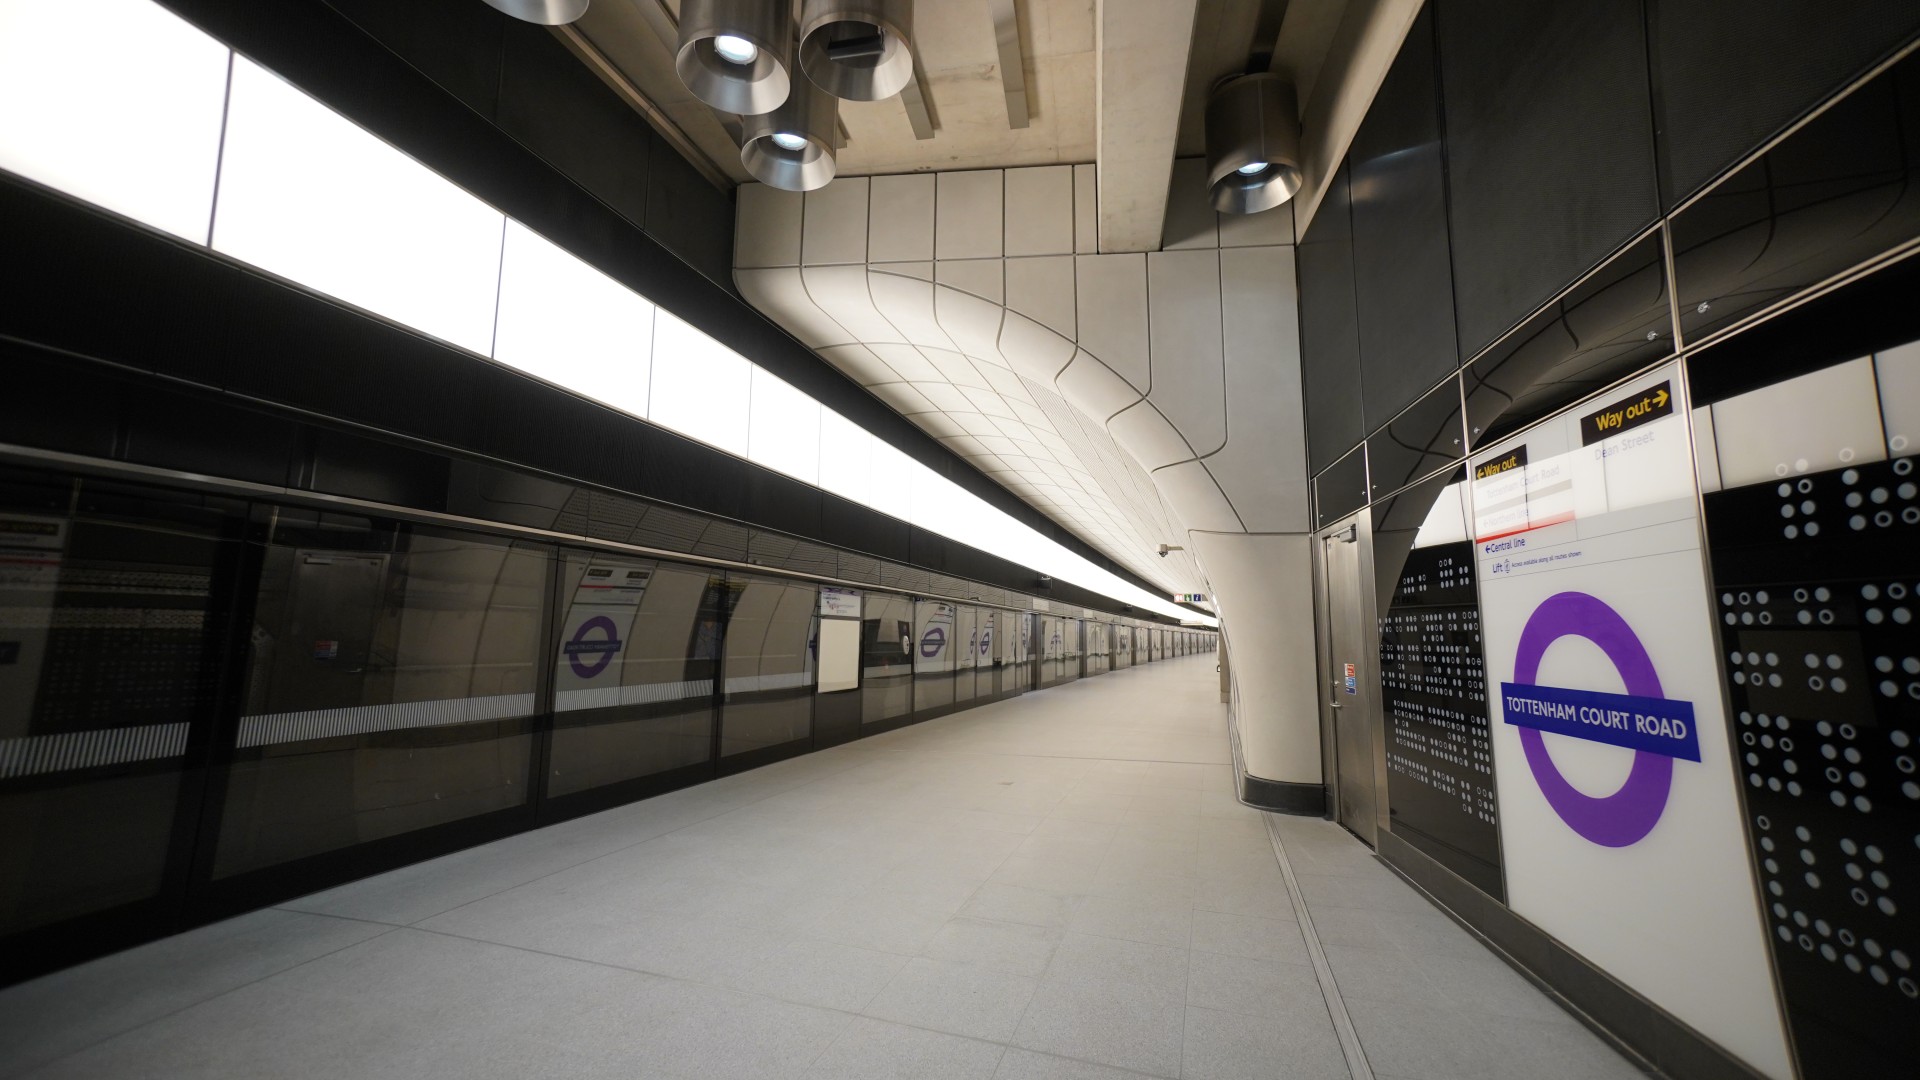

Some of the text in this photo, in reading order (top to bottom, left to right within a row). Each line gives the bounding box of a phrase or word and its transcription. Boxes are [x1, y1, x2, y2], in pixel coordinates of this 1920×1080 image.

[1596, 397, 1652, 431] Way out
[1594, 431, 1656, 461] Dean Street
[1502, 456, 1516, 470] out
[1519, 473, 1539, 487] Court
[1541, 465, 1560, 479] Road
[1490, 537, 1526, 553] Central line
[1492, 563, 1503, 574] Lift
[1506, 696, 1687, 740] TOTTENHAM COURT ROAD
